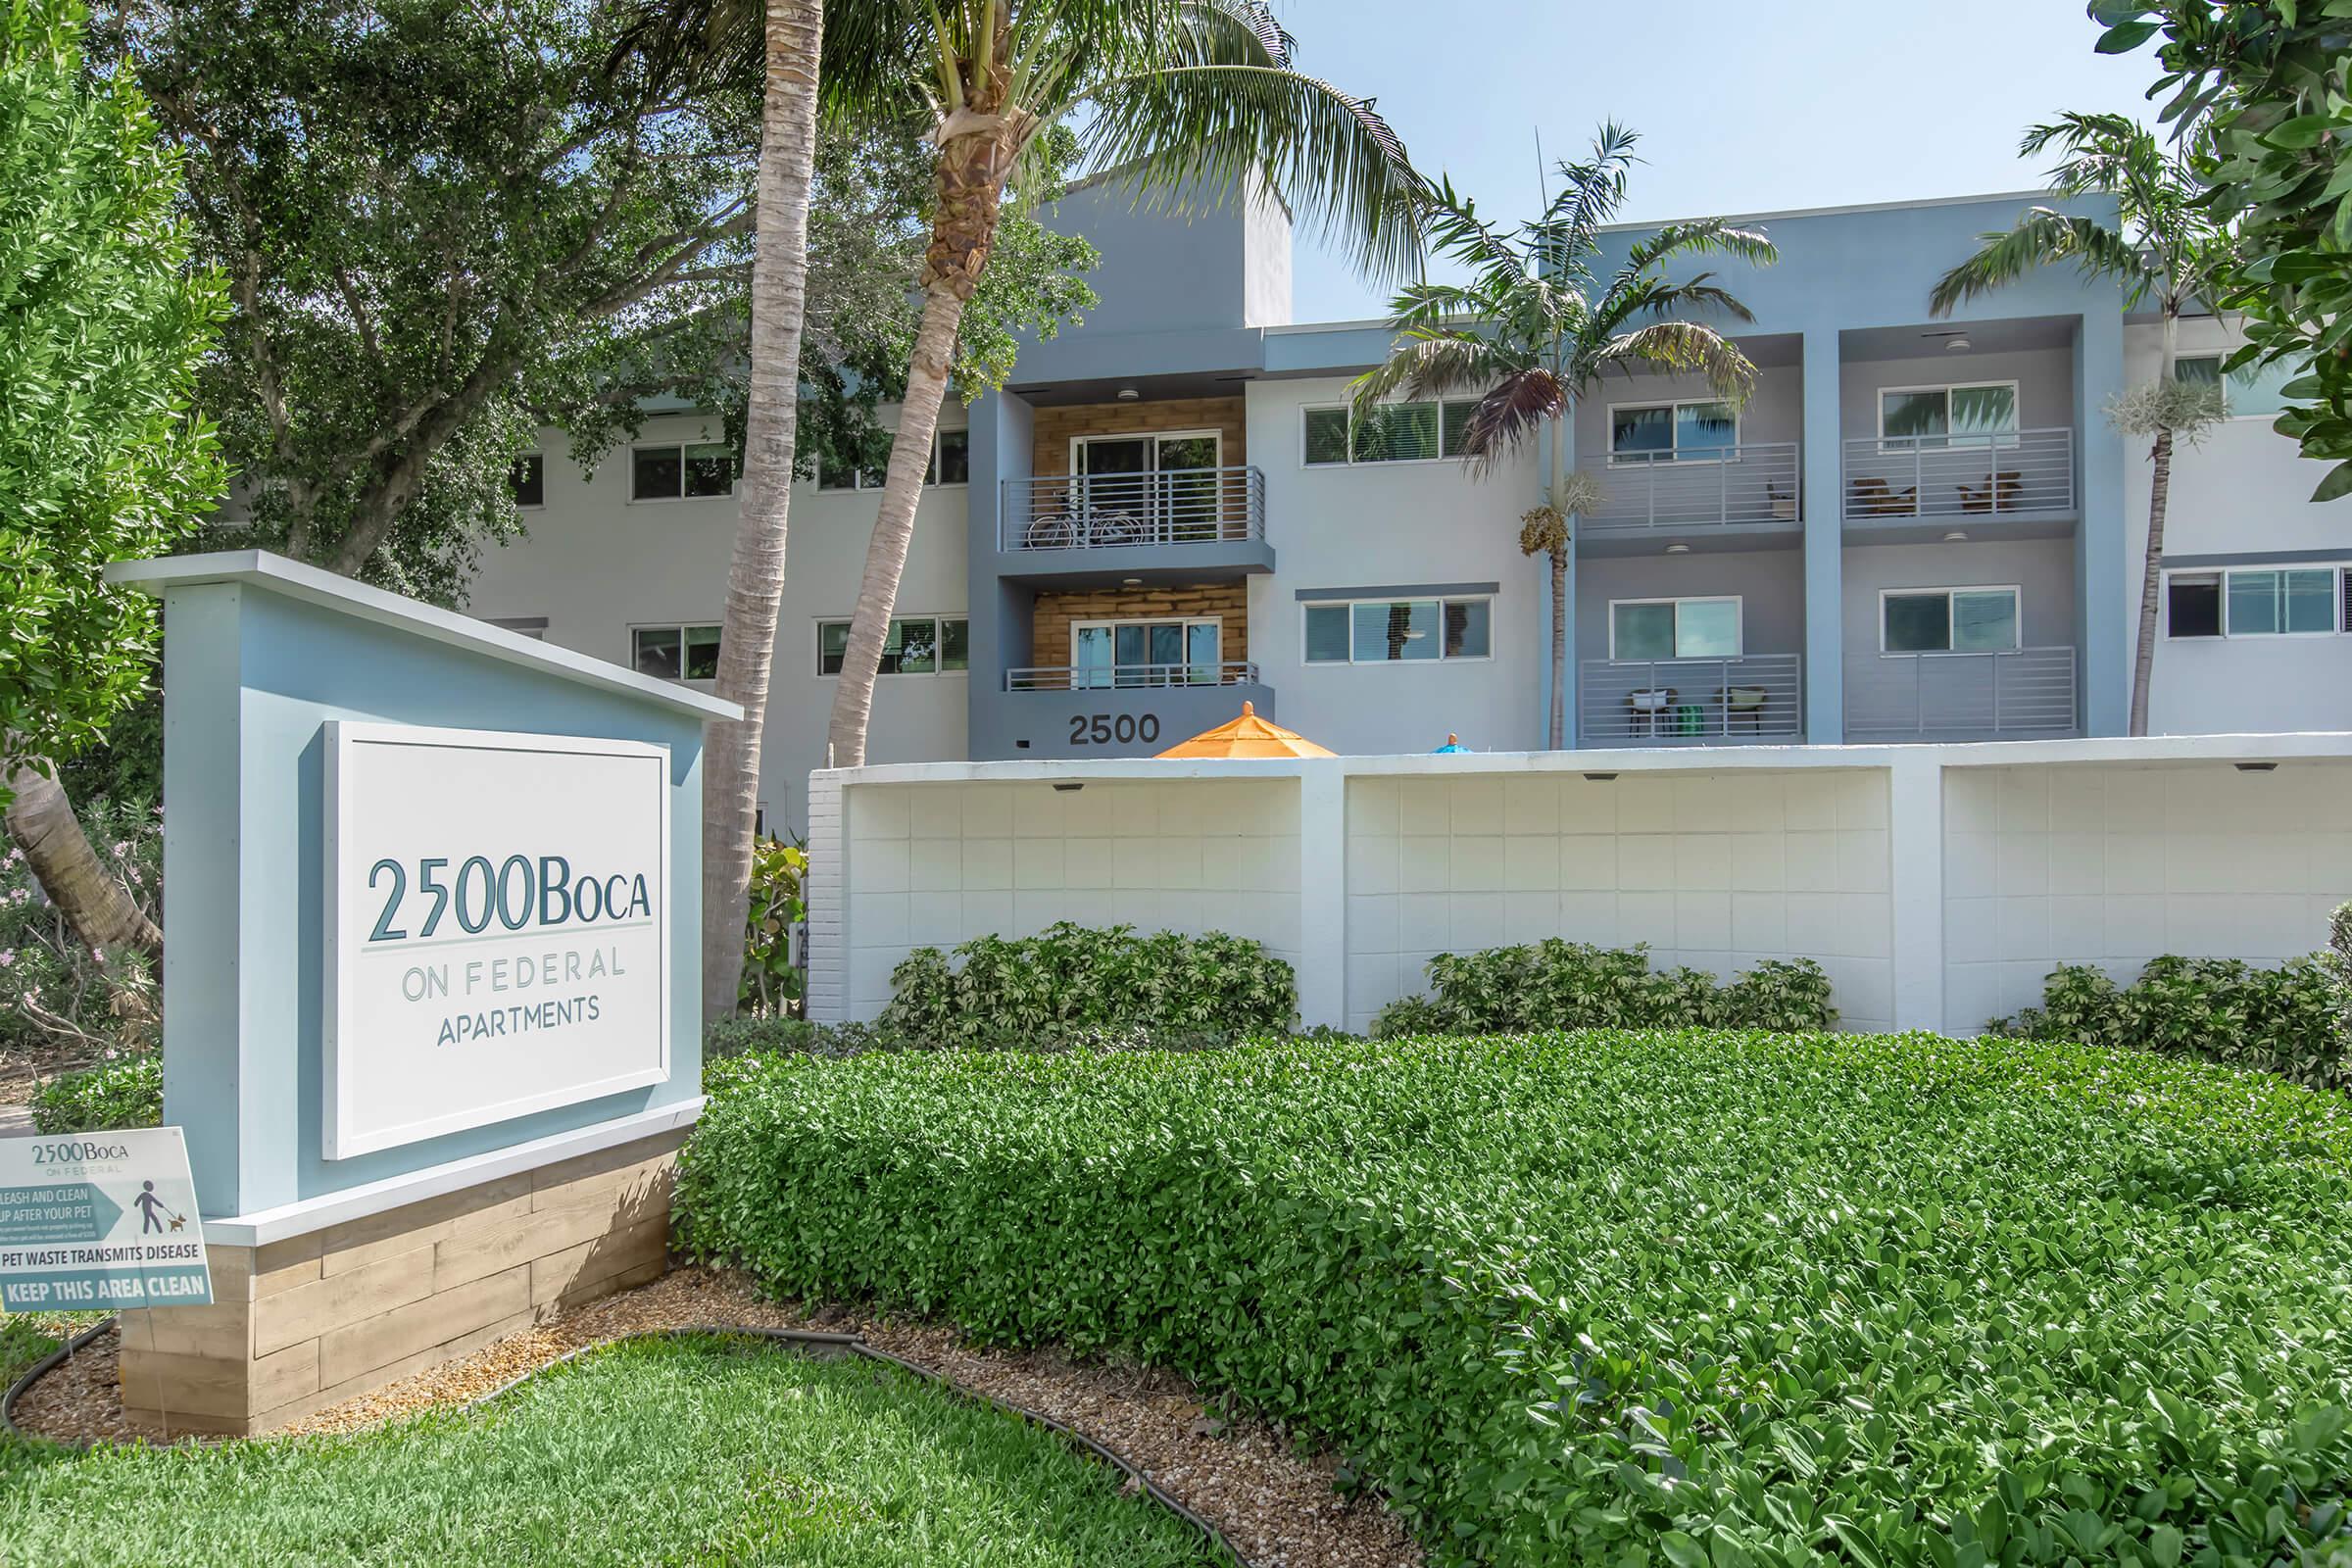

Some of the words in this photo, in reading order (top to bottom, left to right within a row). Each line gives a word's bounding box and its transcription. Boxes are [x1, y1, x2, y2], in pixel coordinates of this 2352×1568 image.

[1069, 713, 1160, 745] 2500
[402, 964, 449, 1002] ON
[466, 947, 626, 995] FEDERAL
[437, 995, 601, 1048] APARTMENTS
[47, 1167, 61, 1176] ON
[65, 1164, 122, 1175] FEDERAL
[31, 1190, 54, 1203] AND
[56, 1188, 88, 1201] CLEAN
[13, 1208, 42, 1222] AFTER
[43, 1206, 73, 1220] YOUR
[74, 1205, 92, 1219] PET
[2, 1252, 23, 1267] PET
[26, 1250, 68, 1266] WASTE
[71, 1247, 143, 1263] TRANSMITS
[147, 1244, 198, 1259] DISEASE
[7, 1282, 49, 1302] KEEP
[53, 1280, 93, 1300] THIS
[98, 1278, 145, 1298] AREA
[148, 1275, 205, 1297] CLEAN
